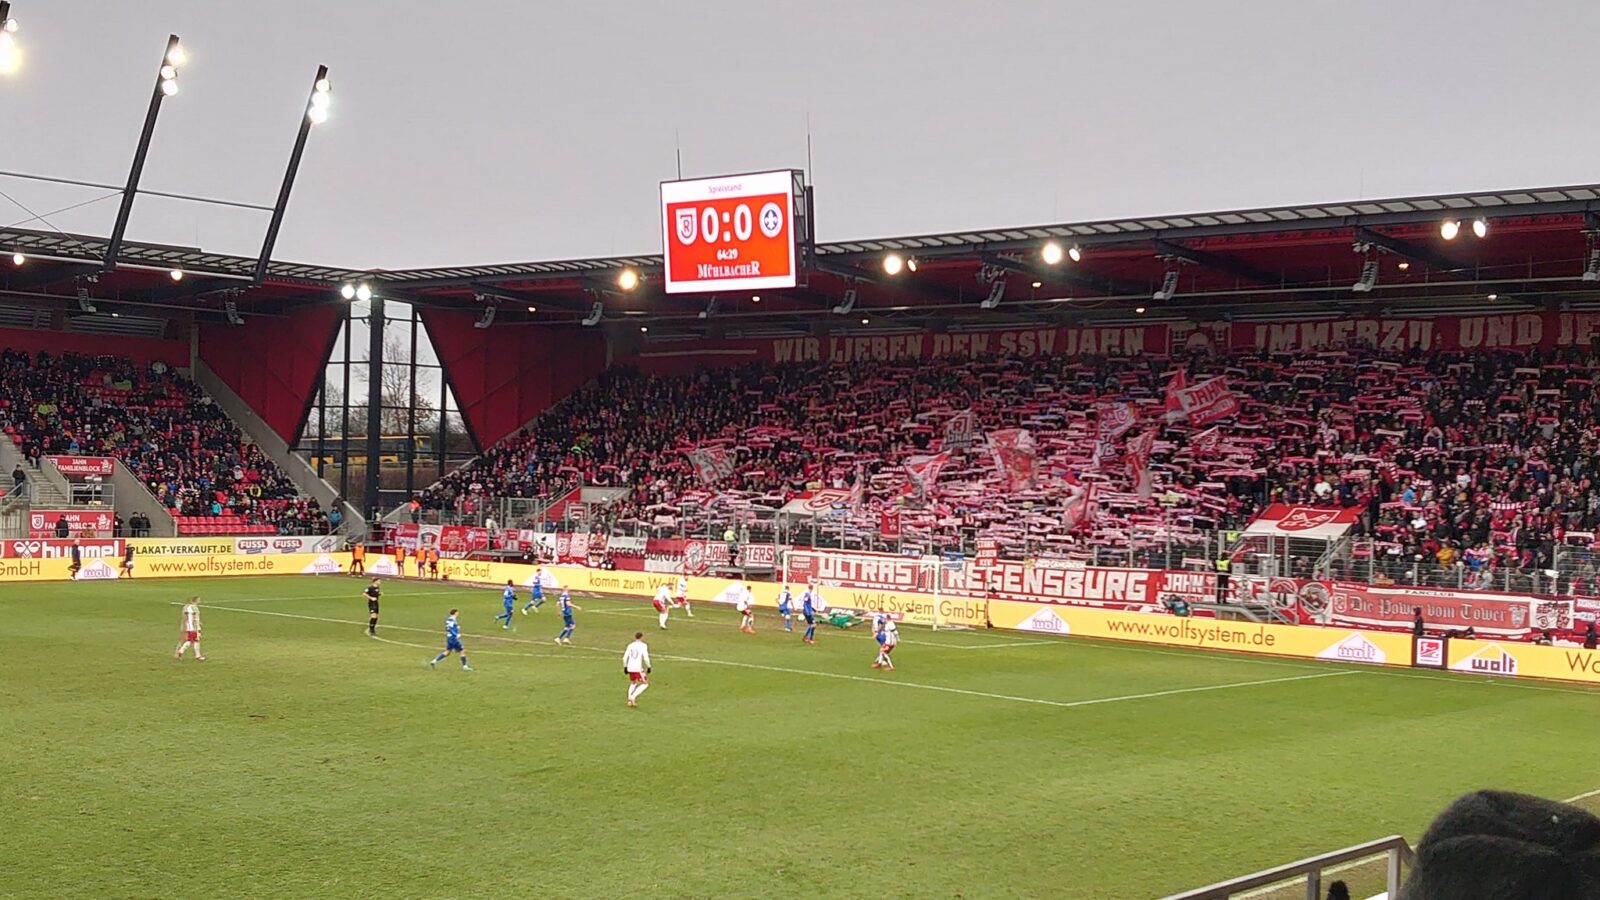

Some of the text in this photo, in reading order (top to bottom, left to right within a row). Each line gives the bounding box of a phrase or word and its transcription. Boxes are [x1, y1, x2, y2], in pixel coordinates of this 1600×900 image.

[701, 204, 753, 244] 0:0
[716, 248, 739, 261] 64:29
[1254, 318, 1434, 351] IMMERZU
[1458, 314, 1543, 348] UND
[773, 326, 1145, 363] WIR LIEBEN DEN SSV JAHN
[58, 464, 101, 473] FAMILIENBLOCK
[240, 540, 267, 549] FUSSL
[275, 540, 302, 548] FUSSL
[149, 556, 274, 574] www.wolfsystem.de
[589, 571, 620, 588] komm
[623, 579, 645, 589] zum
[819, 557, 1147, 601] ULTRAS REGENSBURG
[1162, 573, 1205, 592] JAHN
[1404, 589, 1455, 597] FANCLUB
[853, 593, 884, 609] Wolf
[940, 600, 987, 619] GmbH
[1350, 596, 1373, 612] Die
[1427, 604, 1455, 618] vom
[1461, 603, 1506, 621] Tower
[1106, 618, 1276, 646] www.wolfsystem.de
[1471, 652, 1515, 673] wolf
